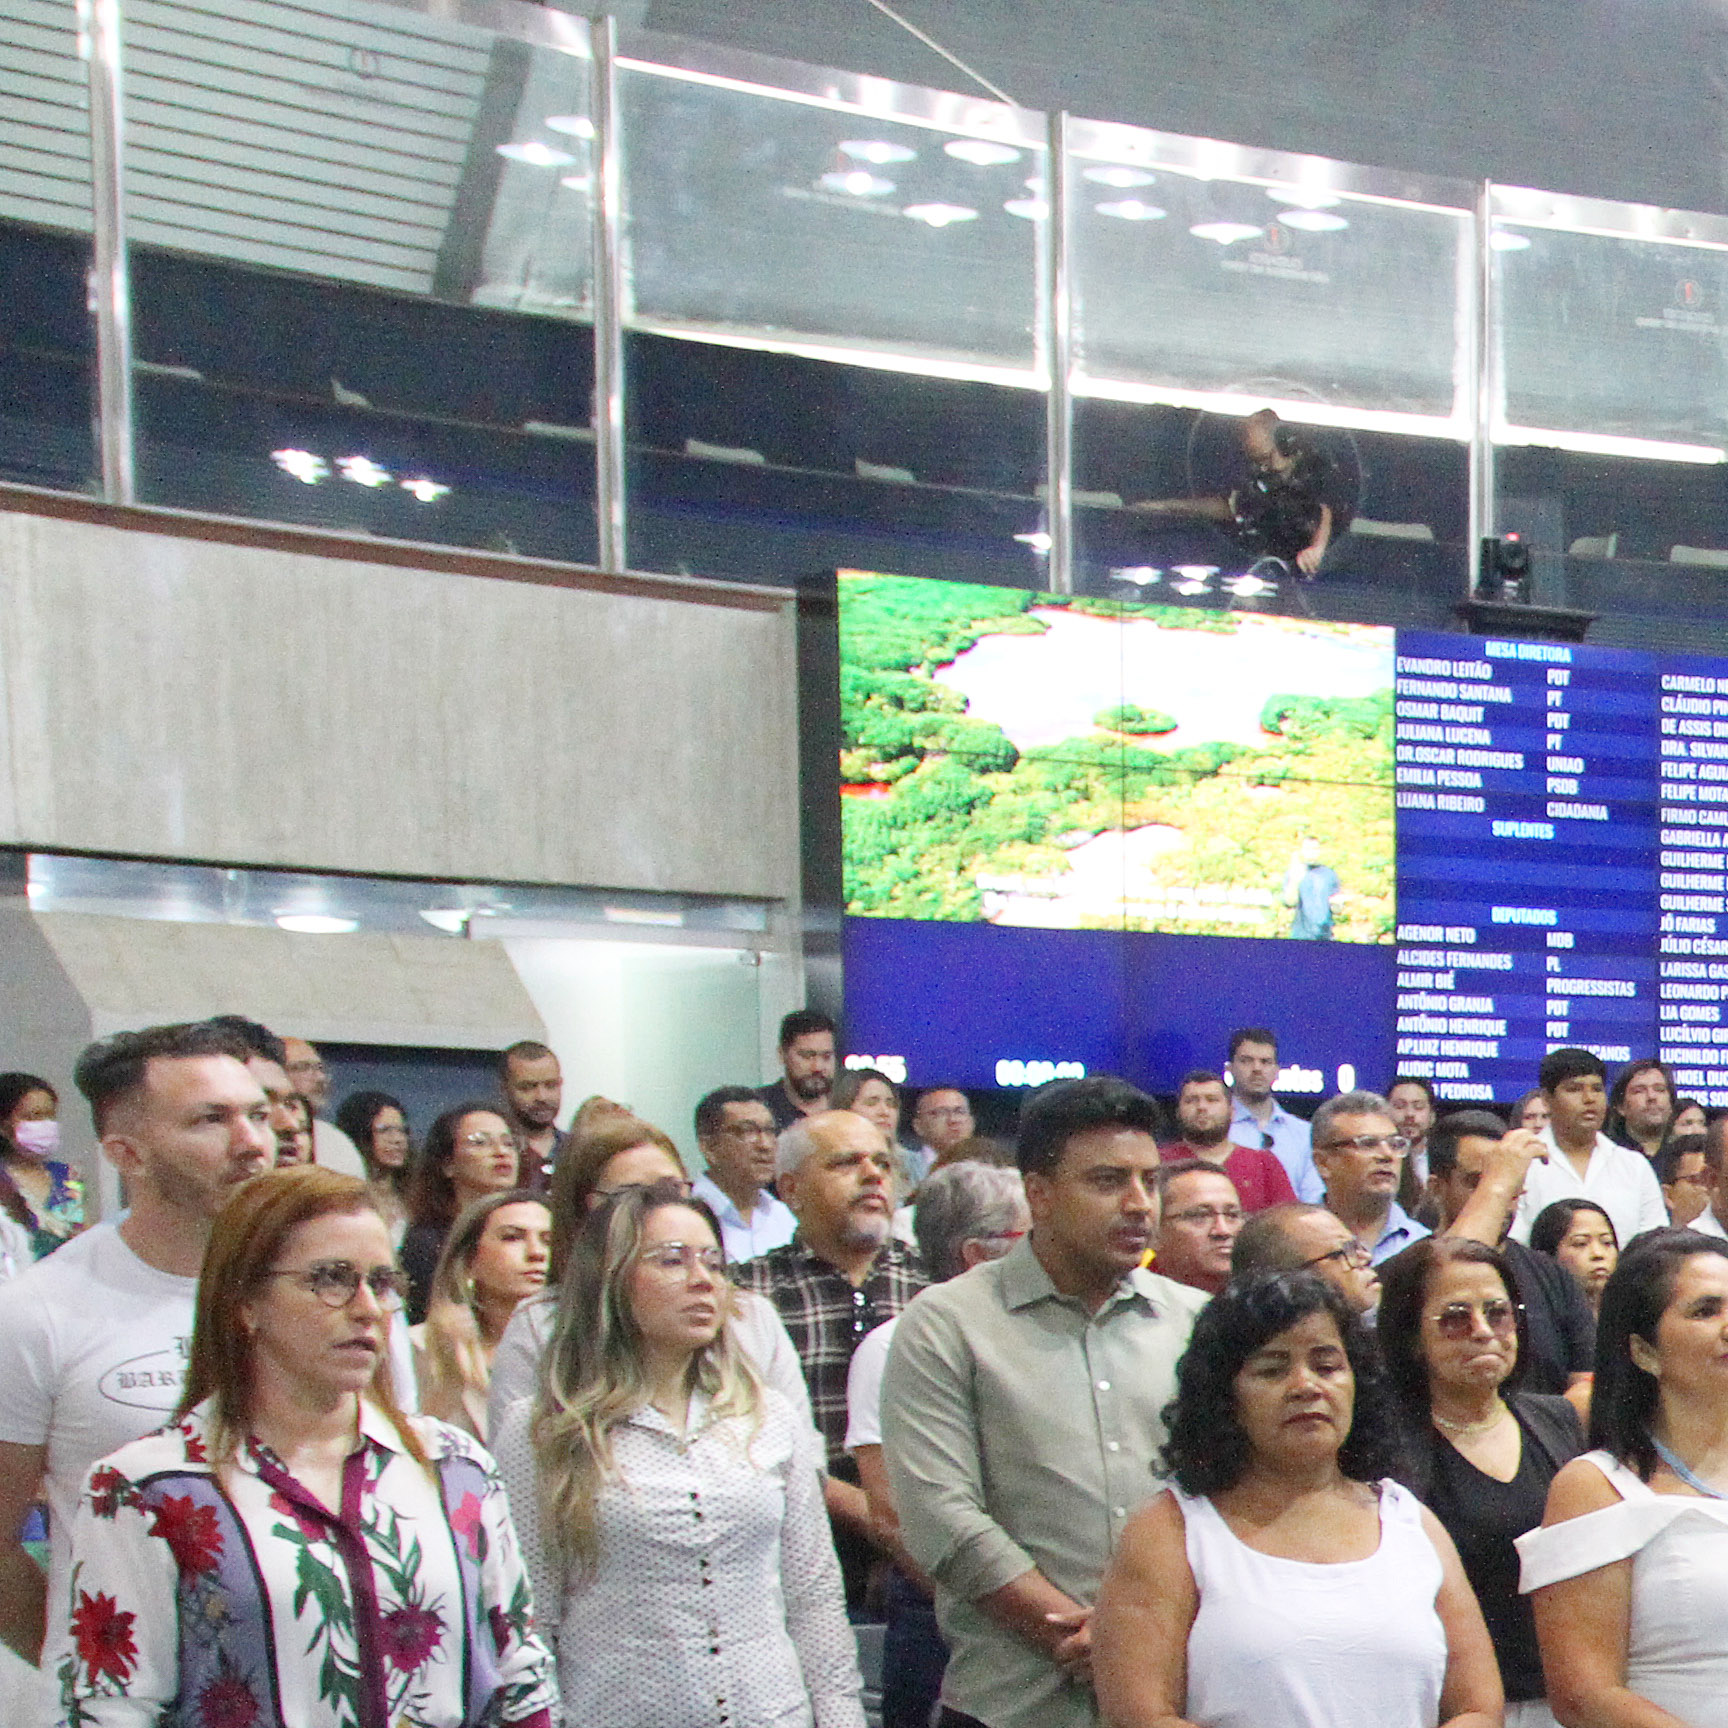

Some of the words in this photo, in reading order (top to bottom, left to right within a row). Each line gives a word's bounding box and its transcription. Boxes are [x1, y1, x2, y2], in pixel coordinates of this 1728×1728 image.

[1485, 641, 1517, 658] MESA
[1518, 644, 1572, 663] DIRETORA
[1397, 656, 1451, 676] EVANDRO
[1453, 661, 1492, 680] LEITÃO
[1547, 668, 1571, 685] PDT
[1397, 678, 1457, 698] FERNANDO
[1459, 684, 1513, 703] SANTANA
[1661, 675, 1715, 692] CARMELO
[1547, 690, 1562, 706] PT
[1661, 695, 1711, 714] CLÁUDIO
[1397, 700, 1439, 719] OSMAR
[1441, 704, 1485, 723] BAQUIT
[1547, 712, 1571, 729] PDT
[1397, 723, 1443, 741] JULIANA
[1446, 727, 1492, 745] LUCENA
[1661, 718, 1677, 734] DE
[1678, 719, 1712, 737] ASSIS
[1547, 734, 1562, 750] PT
[1457, 749, 1524, 770] RODRIGUES
[1437, 770, 1483, 788] PESSOA
[1661, 762, 1697, 779] FELIPE
[1547, 777, 1579, 795] PSDB
[1661, 783, 1697, 801] FELIPE
[1397, 792, 1436, 809] LUANA
[1437, 794, 1485, 812] RIBEIRO
[1547, 802, 1609, 820] CIDADANIA
[1661, 808, 1697, 824] FIRMO
[1492, 820, 1555, 840] SUPLENTES
[1661, 829, 1720, 847] GABRIELLA
[1660, 852, 1724, 869] GUILHERME
[1660, 873, 1724, 891] GUILHERME
[1660, 894, 1724, 912] GUILHERME
[1492, 906, 1557, 925] DEPUTADOS
[1397, 925, 1443, 942] AGENOR
[1446, 927, 1476, 944] NETO
[1676, 917, 1716, 934] FARIAS
[1546, 932, 1574, 948] MDB
[1660, 935, 1691, 954] JÚLIO
[1693, 936, 1728, 955] CÉSAR
[1397, 949, 1445, 967] ALCIDES
[1447, 952, 1513, 970] FERNANDES
[1546, 956, 1561, 972] PL
[1660, 962, 1707, 978] LARISSA
[1397, 972, 1434, 989] ALMIR
[1435, 970, 1454, 990] BIÉ
[1546, 977, 1636, 997] PROGRESSISTAS
[1660, 983, 1719, 1001] LEONARDO
[1397, 991, 1447, 1012] ANTÔNIO
[1449, 996, 1494, 1013] GRANJA
[1546, 999, 1570, 1016] PDT
[1660, 1005, 1678, 1021] LIA
[1680, 1006, 1720, 1022] GOMES
[1397, 1013, 1447, 1033] ANTÔNIO
[1449, 1018, 1507, 1036] HENRIQUE
[1546, 1021, 1570, 1038] PDT
[1440, 1040, 1499, 1058] HENRIQUE
[1660, 1048, 1719, 1064] LUCINILDO
[1397, 1061, 1434, 1077] AUDIC
[1436, 1062, 1470, 1078] MOTA
[1440, 1083, 1494, 1100] PEDROSA
